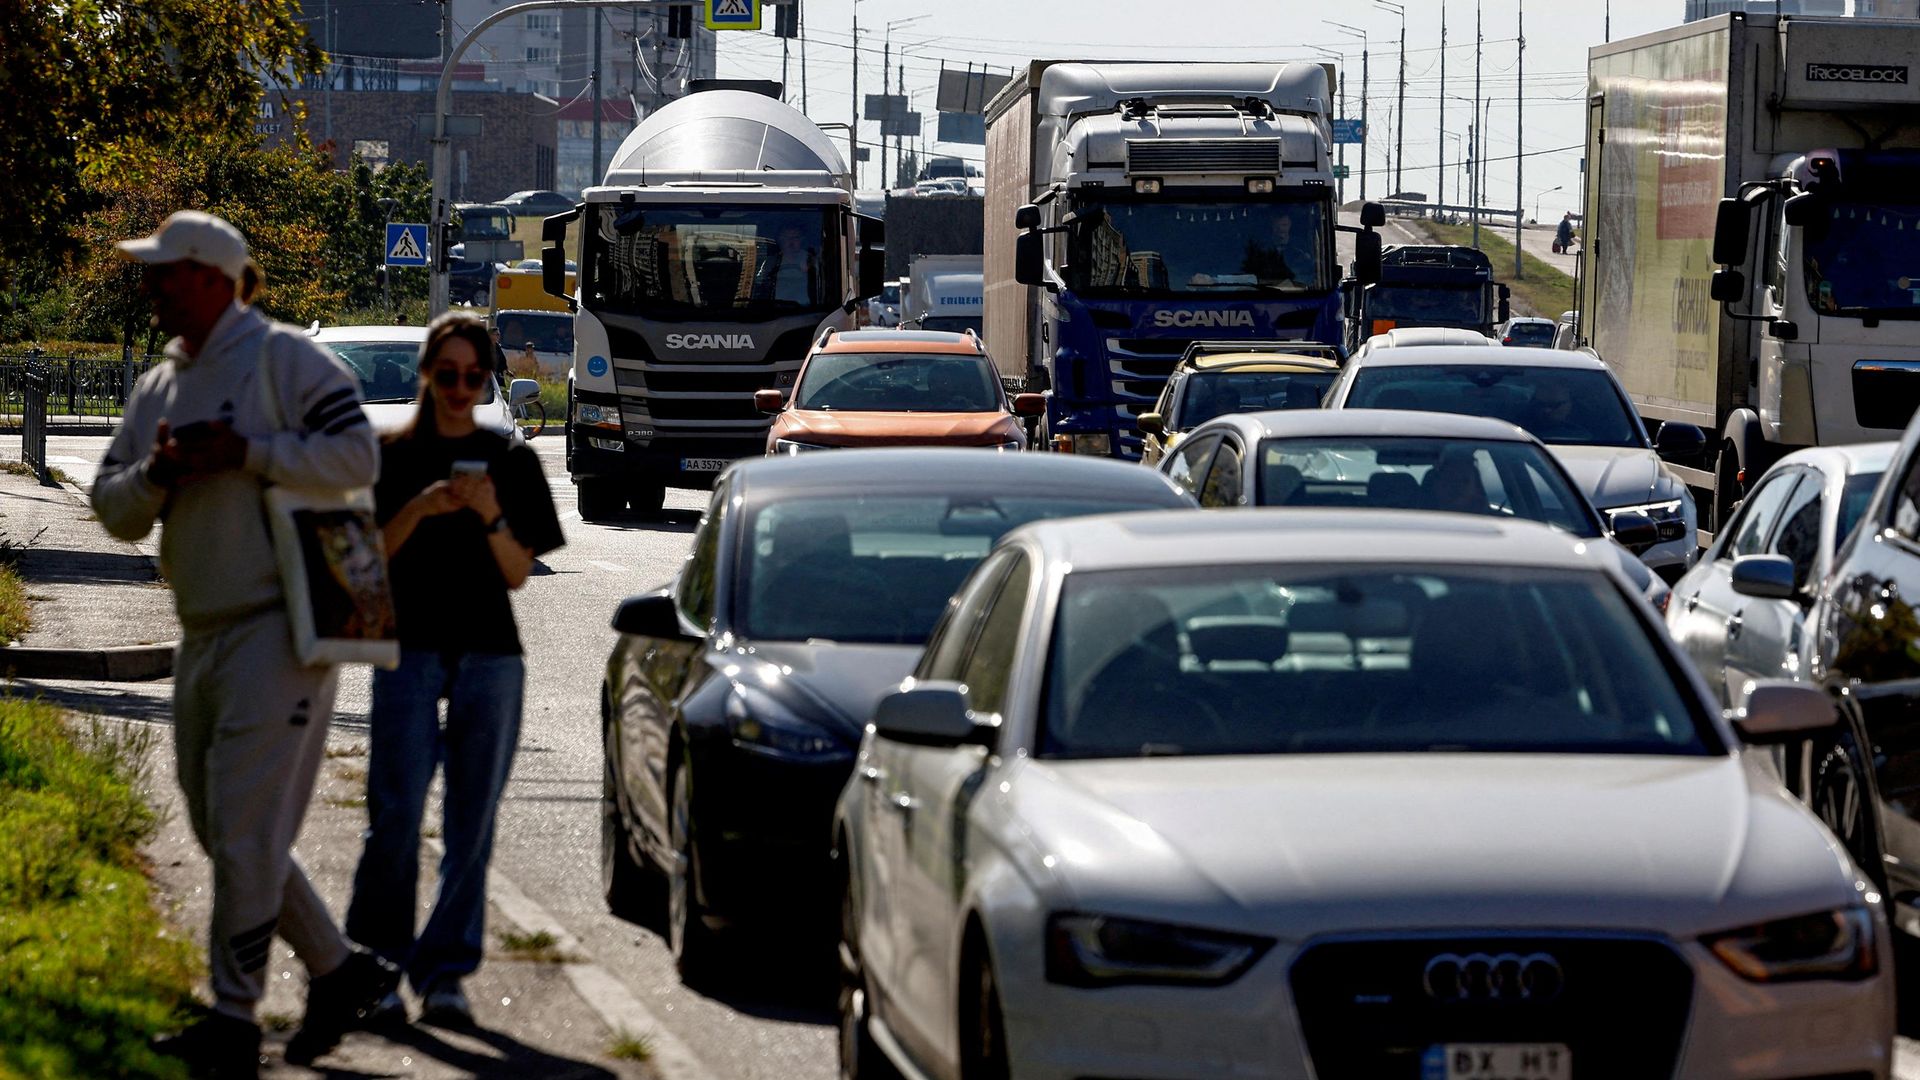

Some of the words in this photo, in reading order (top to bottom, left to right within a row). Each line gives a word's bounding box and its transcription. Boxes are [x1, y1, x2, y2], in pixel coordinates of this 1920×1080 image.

[1808, 65, 1904, 82] FRIGOBLOCK
[251, 124, 281, 134] RKET
[1153, 310, 1255, 327] SCANIA
[665, 334, 755, 349] SCANIA
[686, 460, 699, 470] AA
[701, 460, 723, 470] 3579
